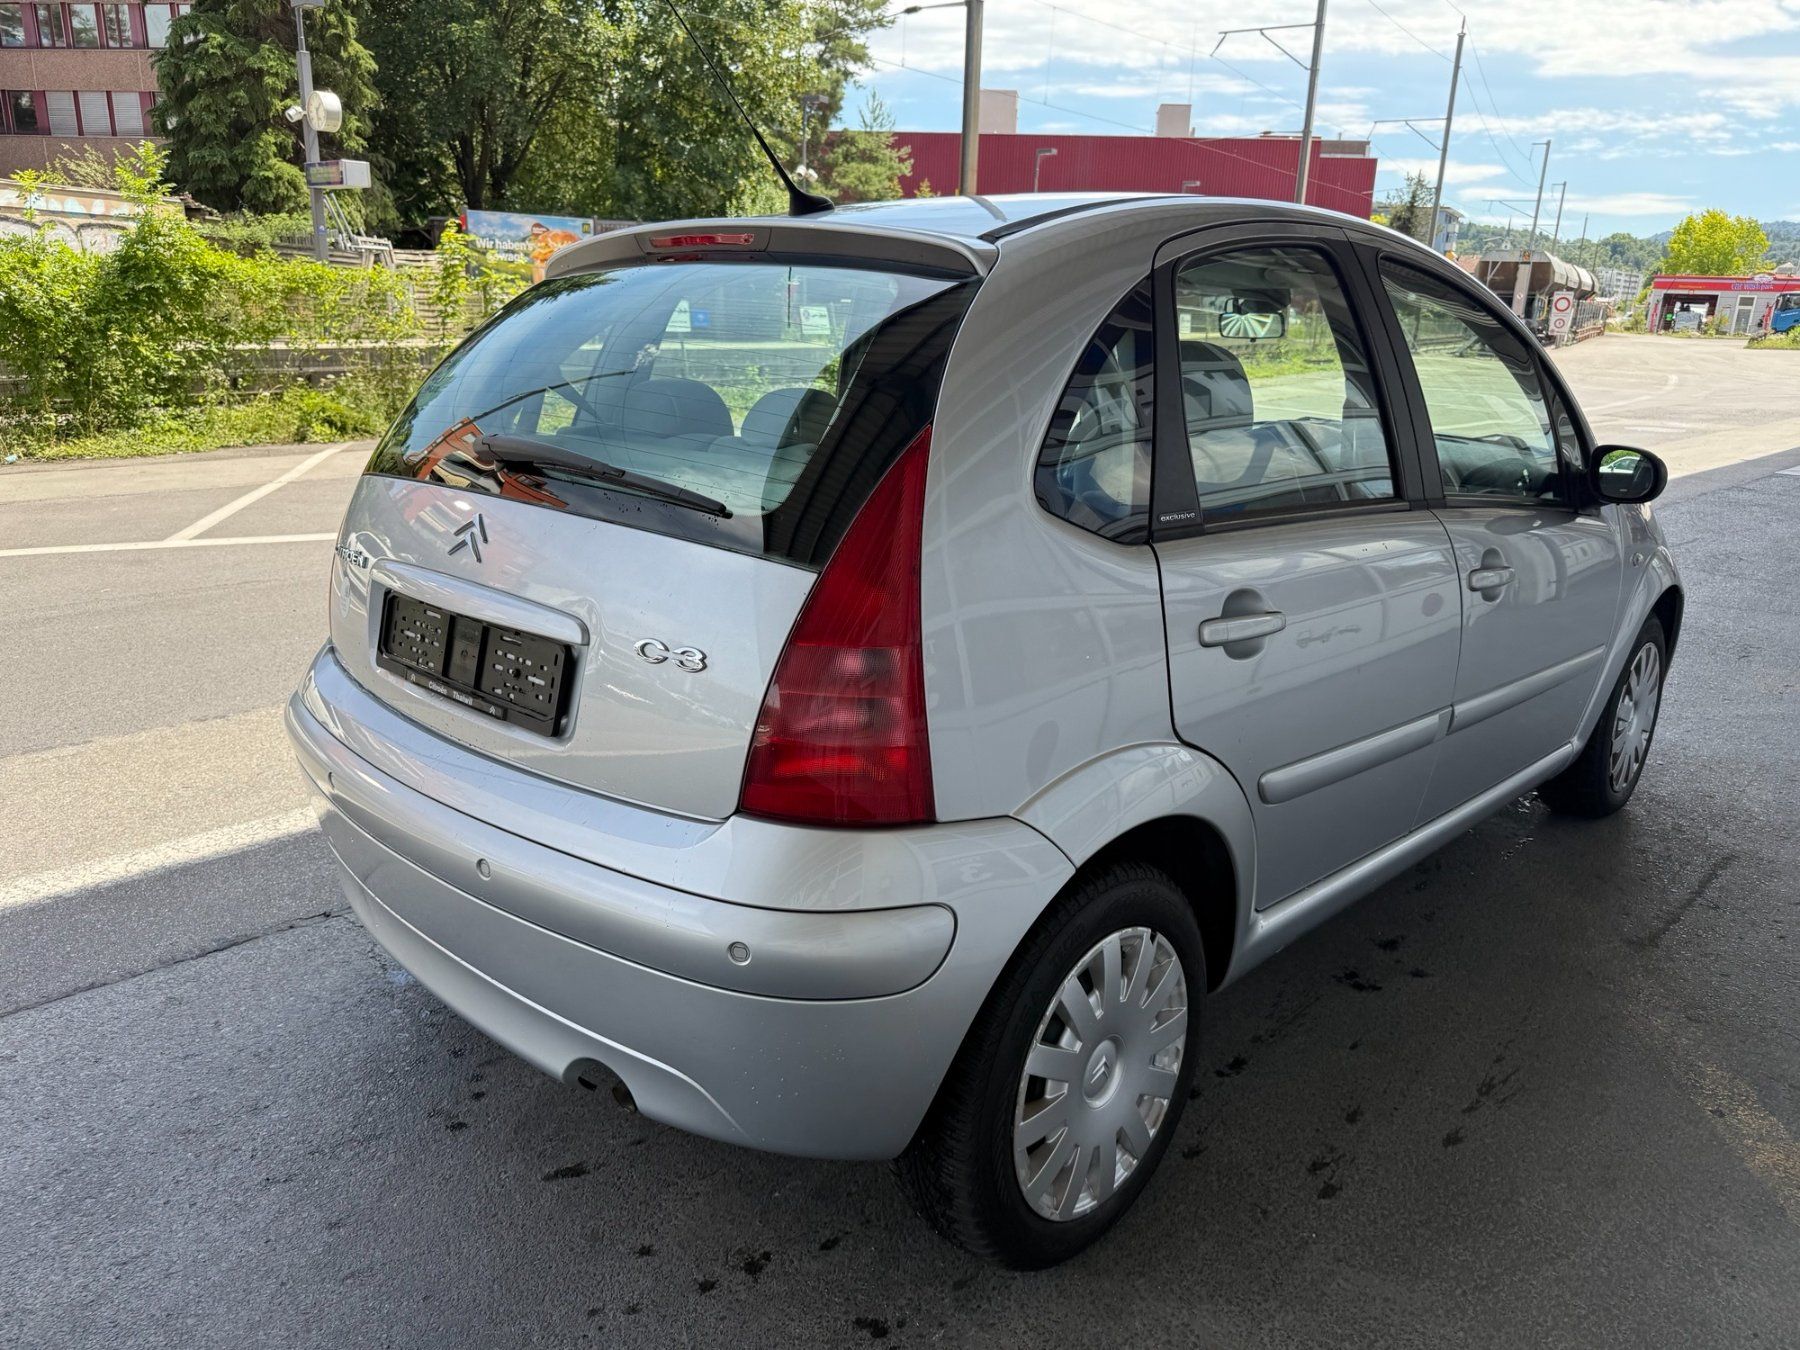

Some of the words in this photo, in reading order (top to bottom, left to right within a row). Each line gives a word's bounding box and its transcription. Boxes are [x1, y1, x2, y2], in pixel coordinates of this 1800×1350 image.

[475, 237, 494, 250] Wir
[1160, 512, 1195, 522] exclusive
[633, 637, 708, 673] C3
